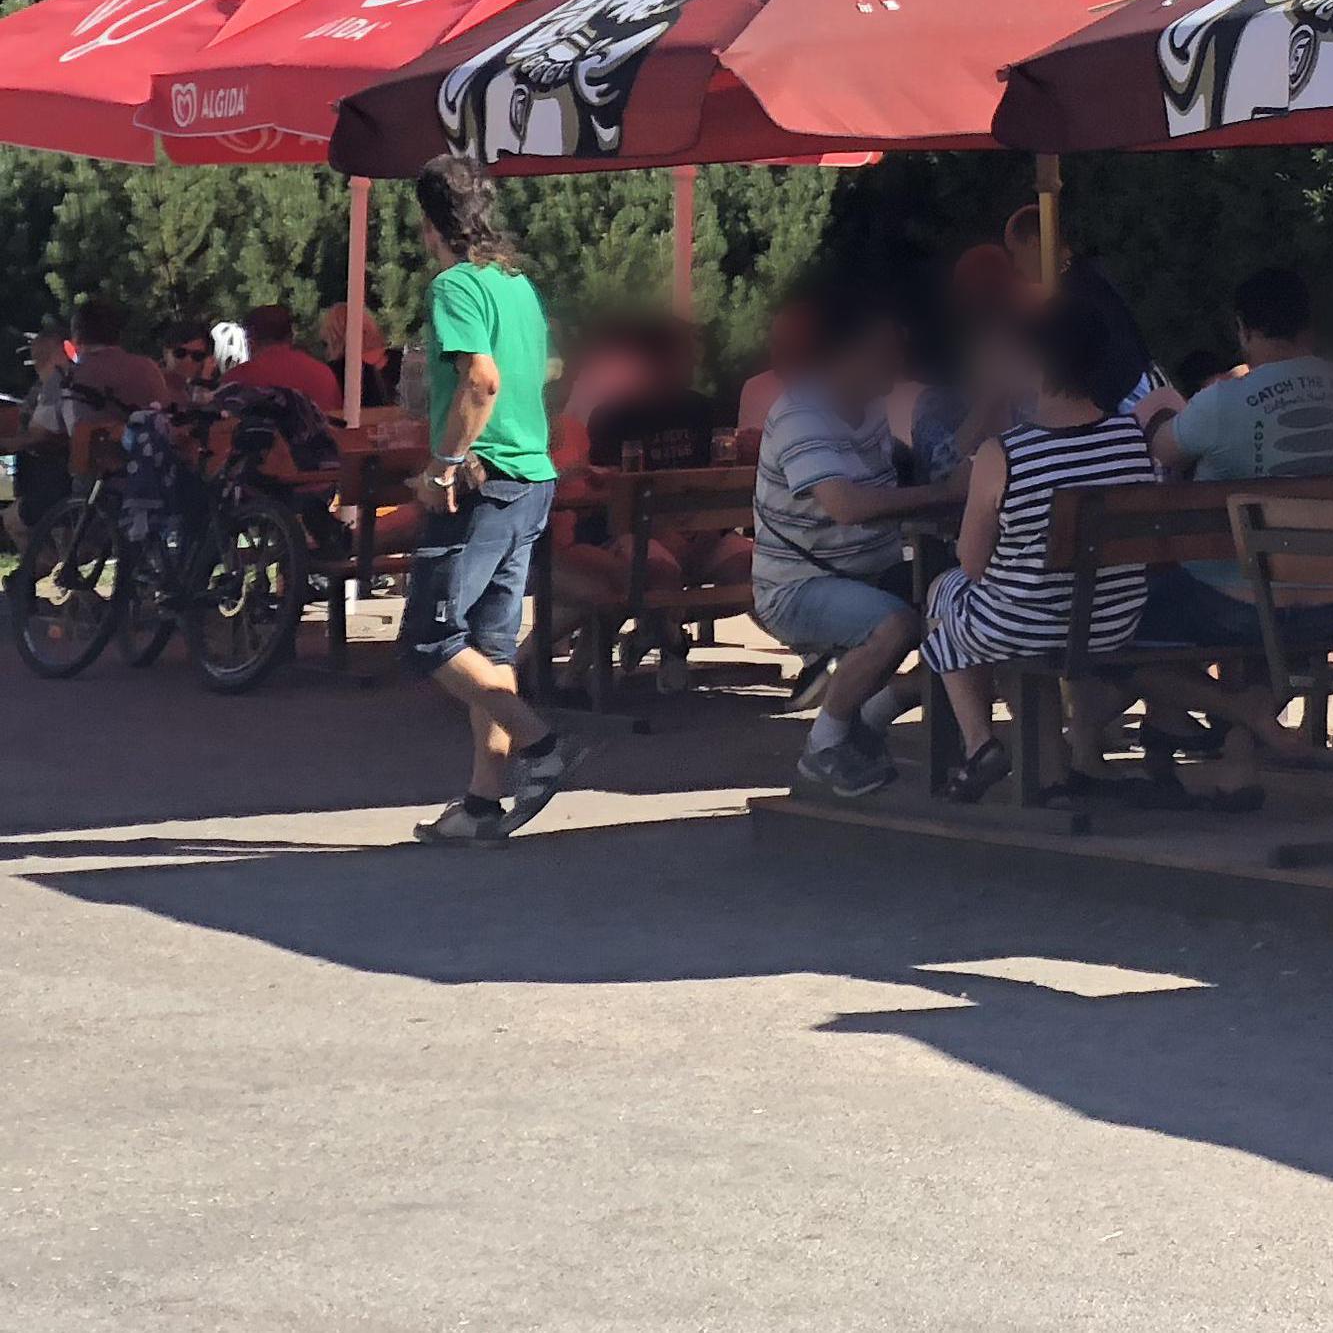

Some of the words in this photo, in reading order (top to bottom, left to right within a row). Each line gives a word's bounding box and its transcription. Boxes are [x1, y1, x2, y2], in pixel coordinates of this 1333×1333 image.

[200, 88, 245, 118] ALGIDA
[1246, 379, 1293, 407] CATCH
[1298, 376, 1325, 390] THE
